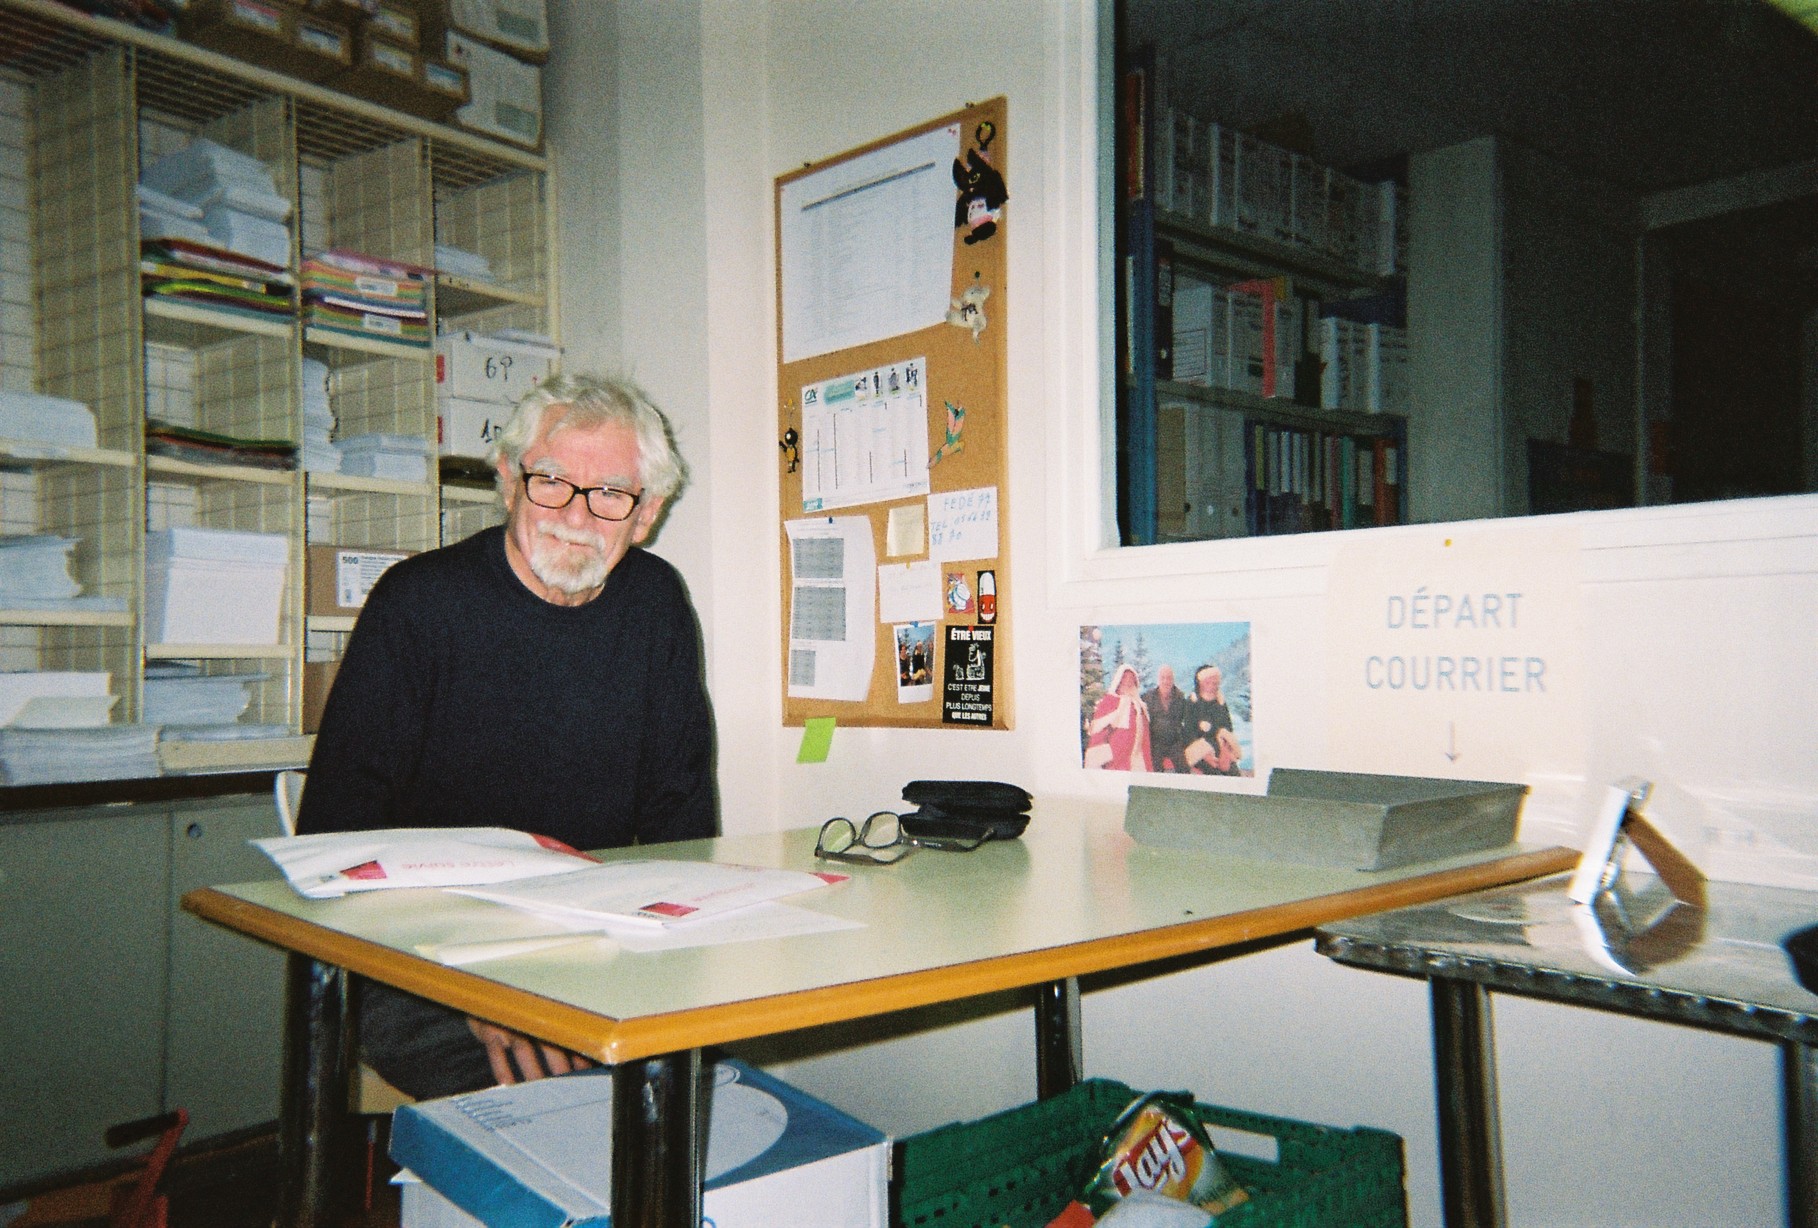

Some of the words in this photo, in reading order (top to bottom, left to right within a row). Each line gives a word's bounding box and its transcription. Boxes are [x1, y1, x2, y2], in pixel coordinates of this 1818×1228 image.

[343, 556, 359, 564] 500
[1387, 586, 1523, 629] DÉPART
[972, 630, 991, 640] VIEUX
[1365, 655, 1548, 692] COURRIER
[961, 693, 980, 701] DEPUIS
[946, 701, 961, 710] PLUS
[962, 703, 992, 712] LONGTEMPS
